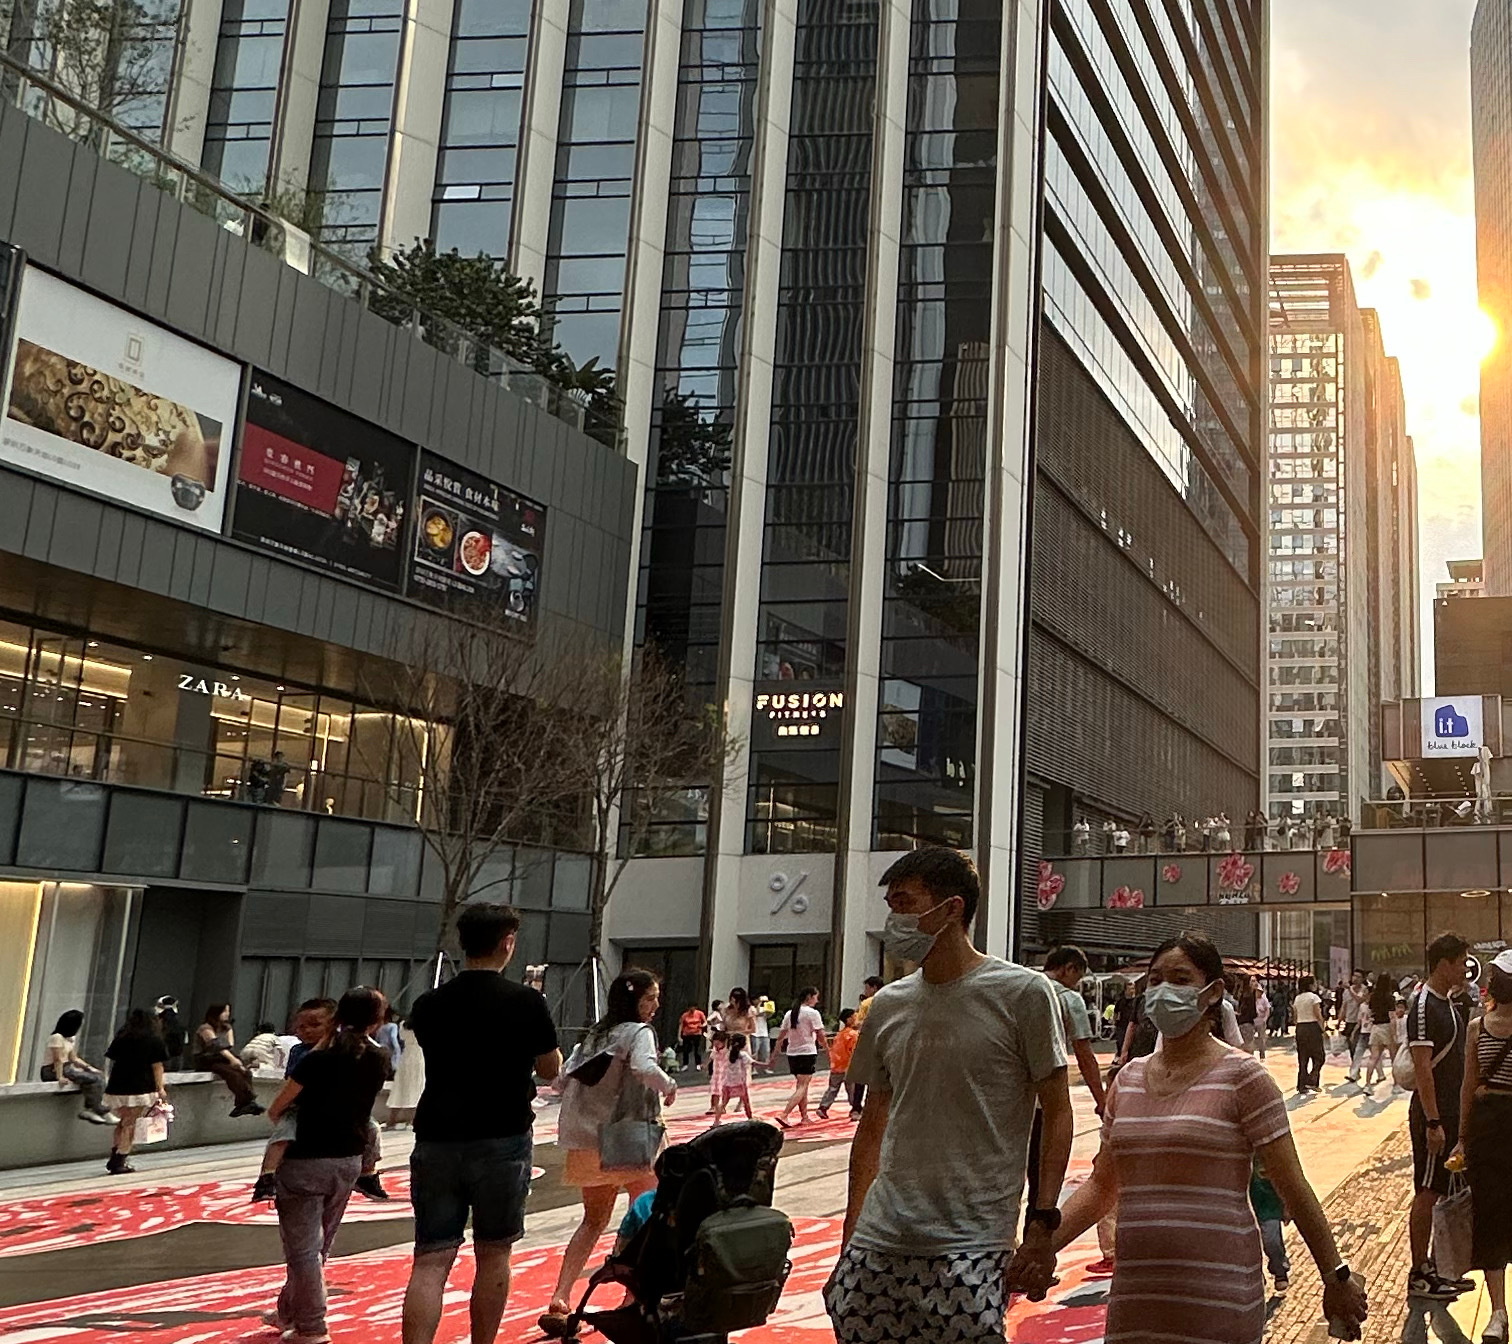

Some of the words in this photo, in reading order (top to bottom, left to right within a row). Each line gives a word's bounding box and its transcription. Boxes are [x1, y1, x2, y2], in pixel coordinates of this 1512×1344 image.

[178, 674, 244, 701] ZARA
[756, 692, 844, 710] FUSION
[1427, 740, 1448, 751] blue
